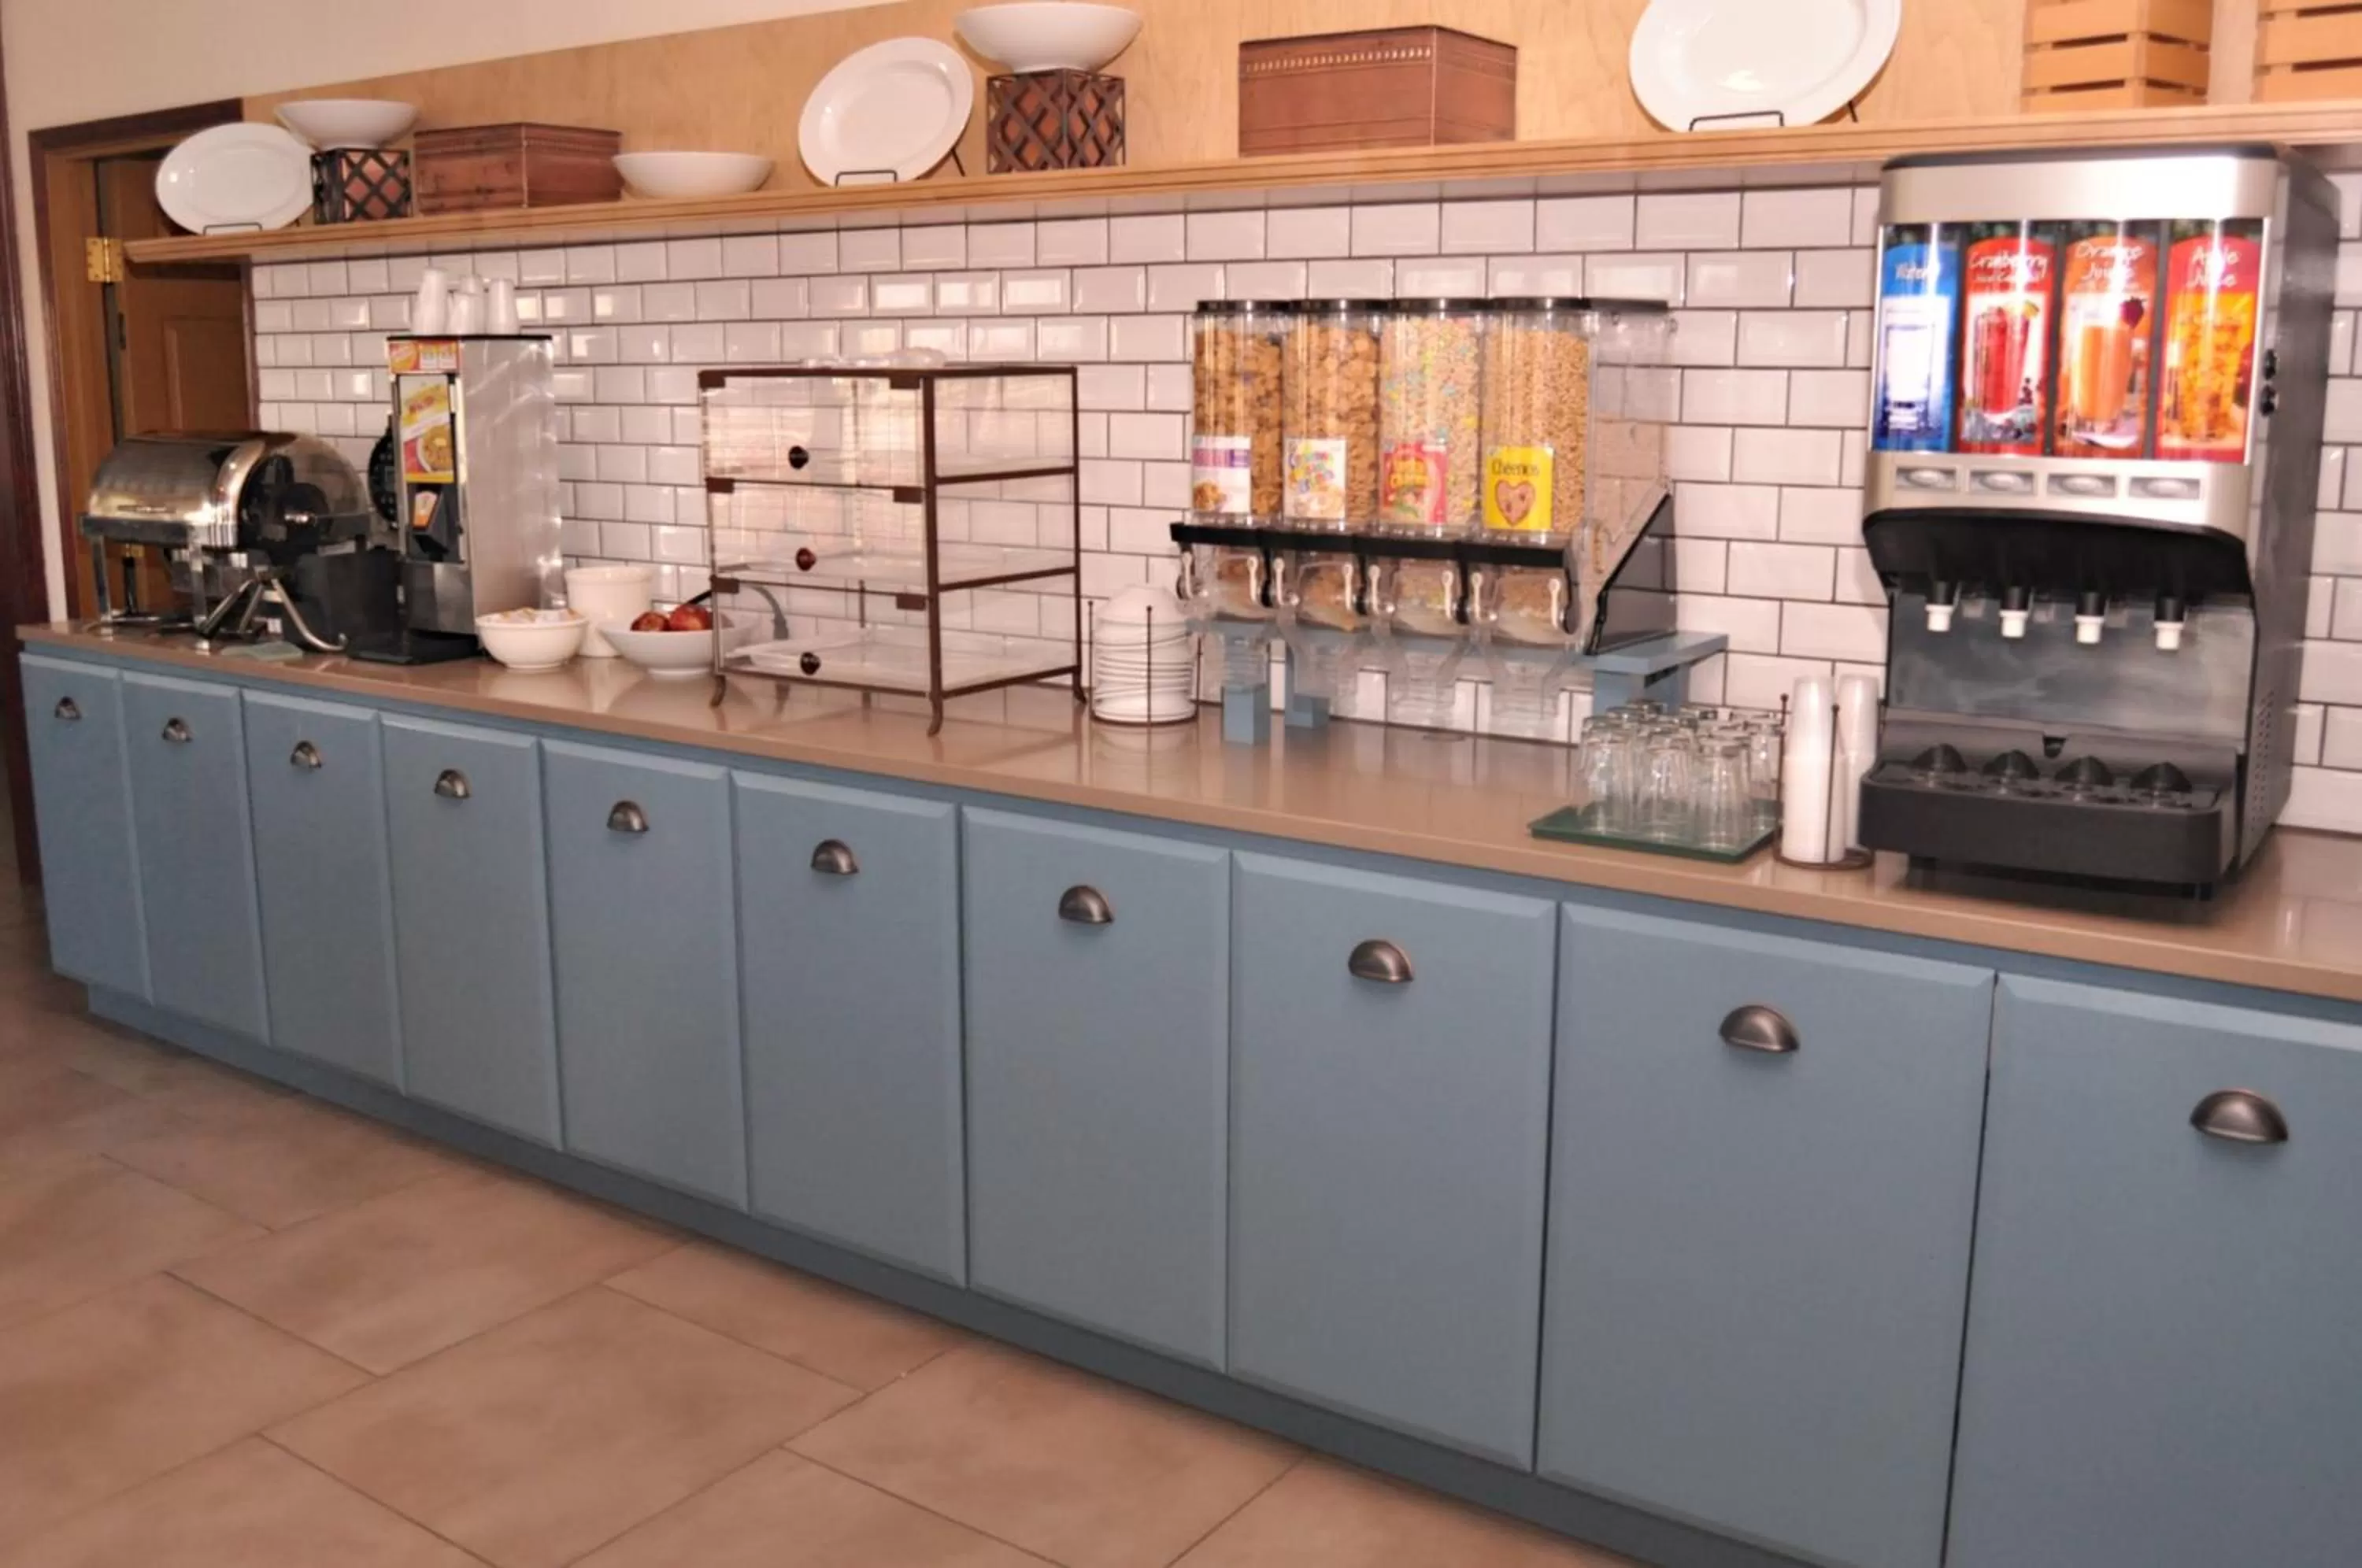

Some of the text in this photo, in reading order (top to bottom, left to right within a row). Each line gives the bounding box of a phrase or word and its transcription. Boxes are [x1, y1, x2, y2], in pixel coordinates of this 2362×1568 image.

[2075, 242, 2143, 263] Orage
[2192, 245, 2239, 267] Ale
[1895, 261, 1938, 280] Wate
[1970, 250, 2048, 279] Cranbery
[2082, 261, 2135, 281] Juie
[2186, 267, 2238, 288] Jue
